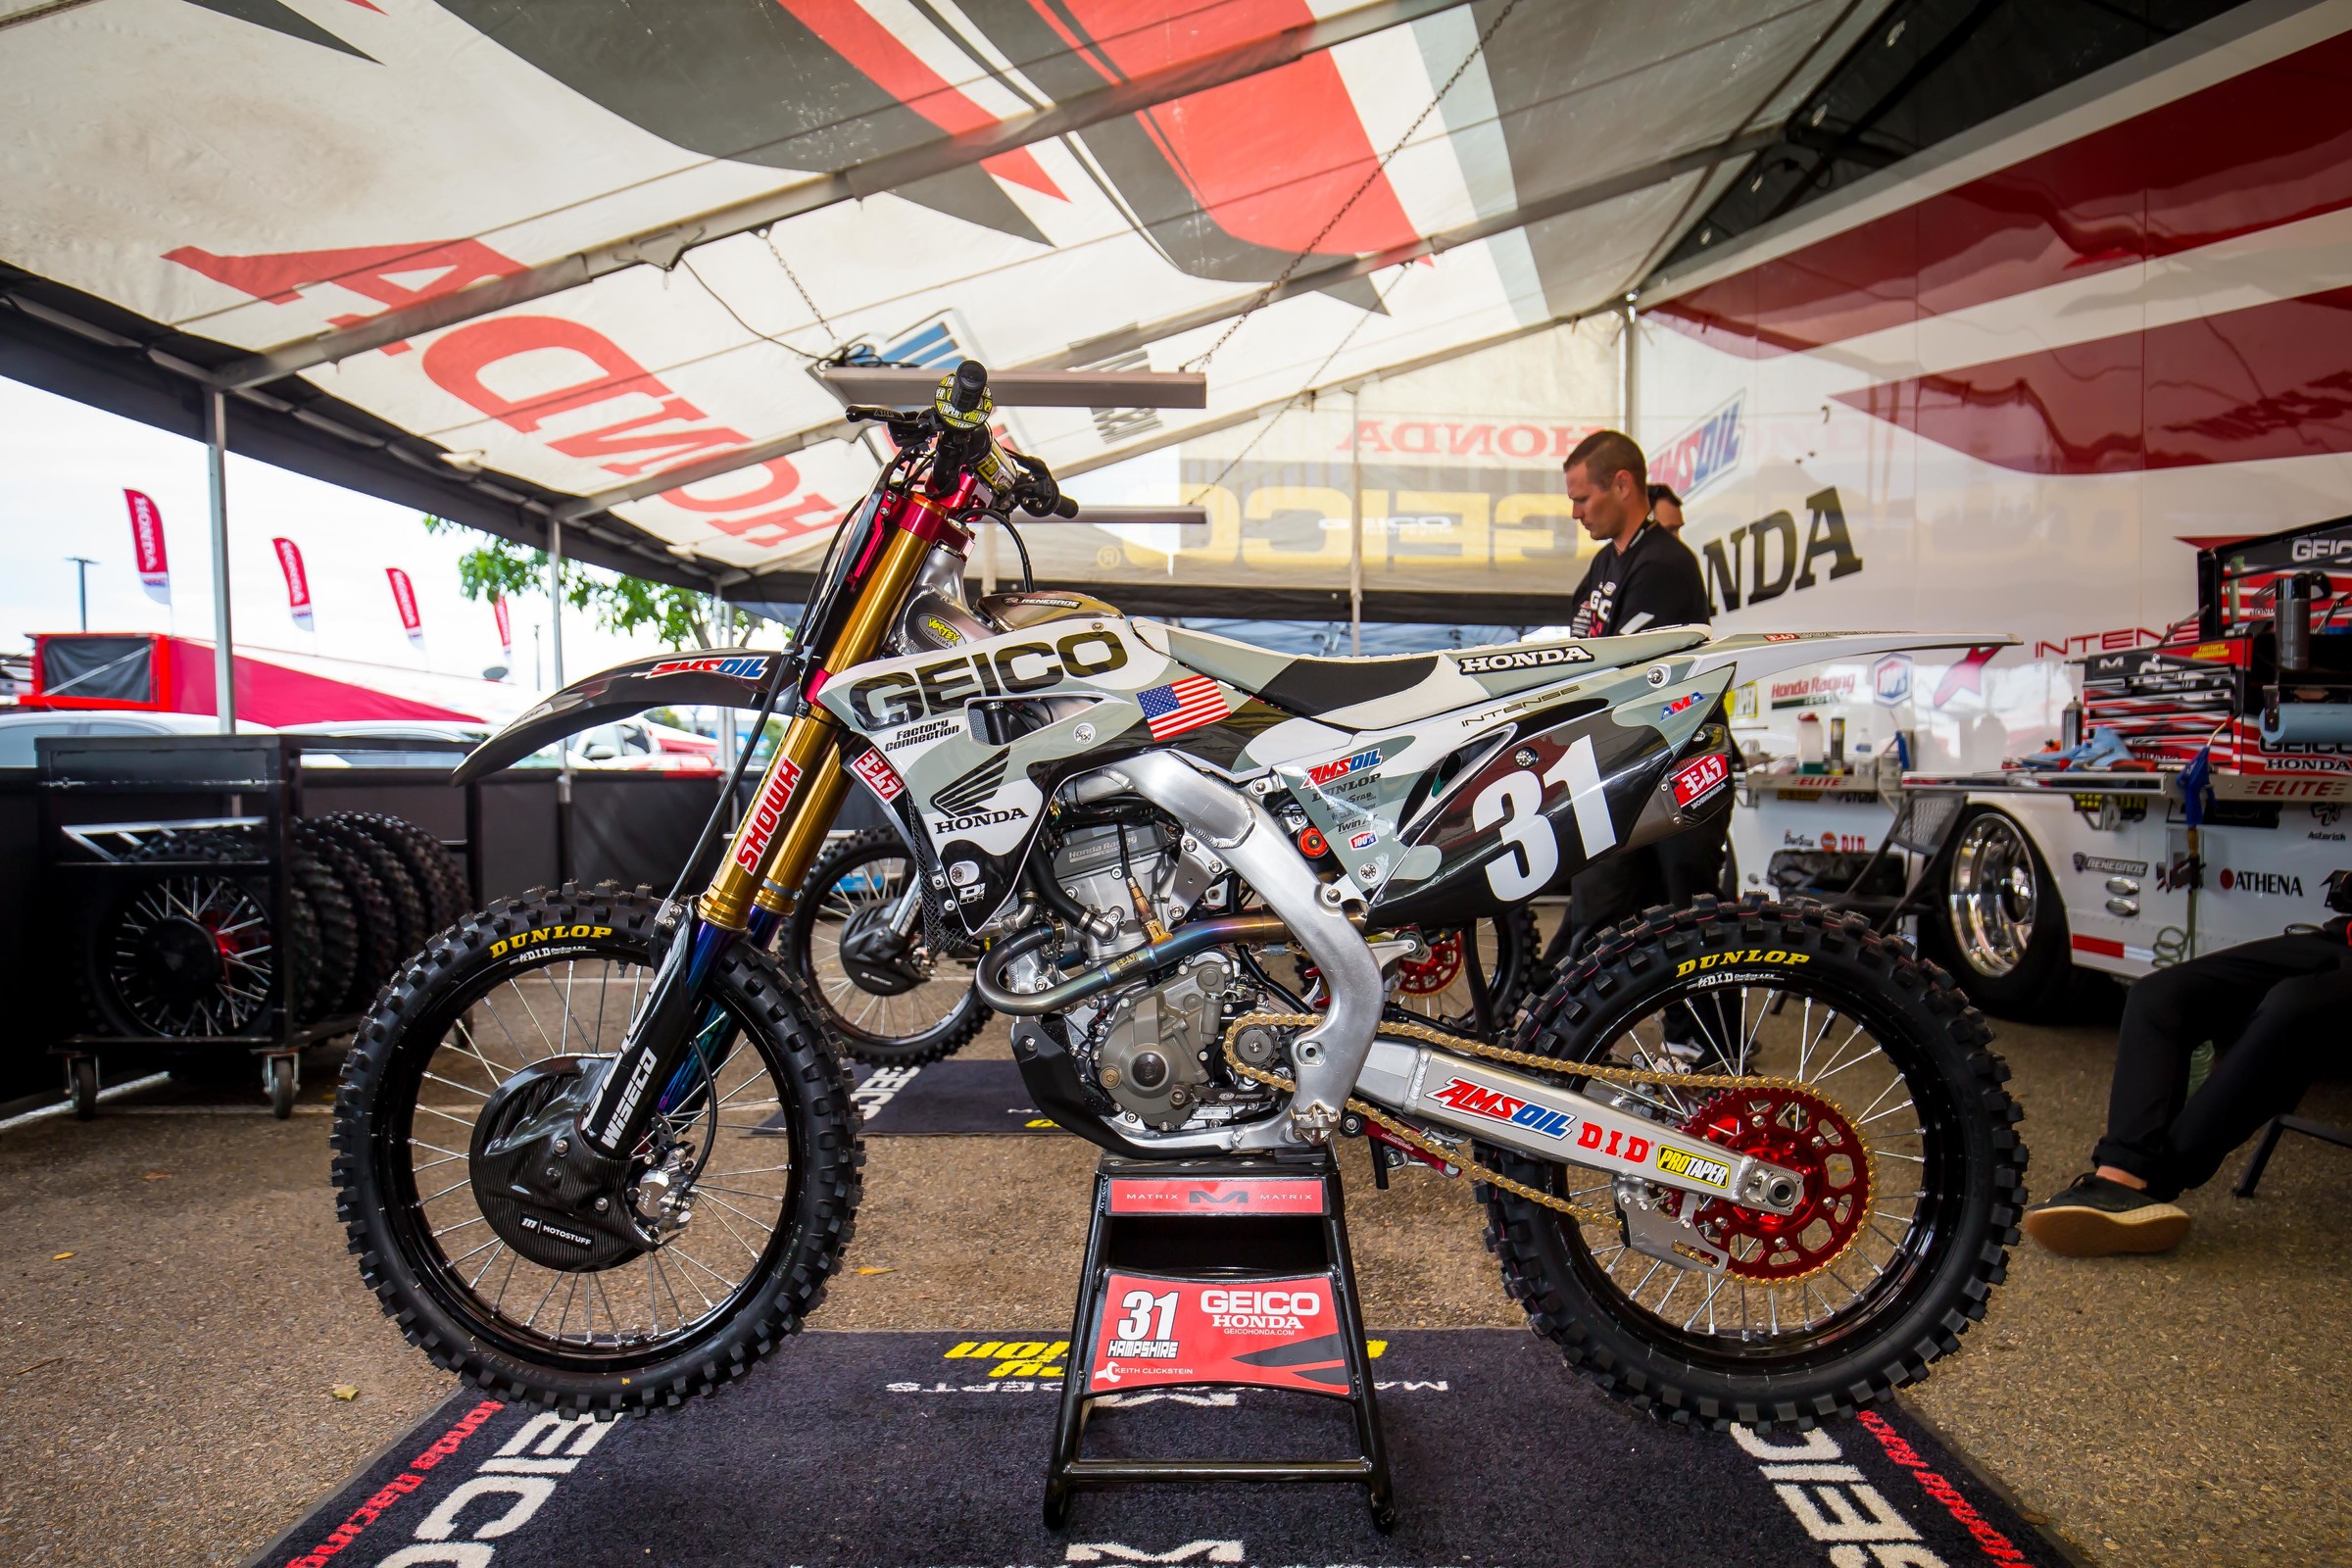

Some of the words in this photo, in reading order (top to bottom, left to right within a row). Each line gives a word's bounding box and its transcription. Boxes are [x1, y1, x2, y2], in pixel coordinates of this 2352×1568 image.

[133, 496, 158, 570] HONDA
[1702, 486, 1863, 617] NDA
[2292, 539, 2352, 563] GEIC
[1021, 598, 1080, 609] RENEGADE
[927, 616, 960, 646] VORTEX
[1460, 648, 1592, 673] HONDA
[850, 631, 1129, 731] GEICO
[1461, 685, 1580, 727] INTENSE
[1659, 692, 1706, 722] AMA
[896, 718, 950, 740] Factory
[1302, 750, 1381, 788] AMSOIL
[2266, 759, 2352, 771] HONDA
[2257, 780, 2331, 797] ELITE
[737, 758, 801, 872] SHOWA
[935, 808, 1029, 834] HONDA
[1473, 734, 1616, 902] 31
[1068, 845, 1103, 859] Honda
[1353, 833, 1377, 848] 100%
[2234, 870, 2303, 897] ATHENA
[490, 925, 612, 958] DUNLOP
[1676, 950, 1810, 978] DUNLOP
[1433, 1078, 1574, 1138] AMSOIL
[1660, 1150, 1729, 1186] PROTAPER
[542, 1225, 592, 1247] MOTOSTUFF
[1116, 1290, 1180, 1341] 31
[1200, 1290, 1321, 1315] GEICO
[1211, 1315, 1304, 1329] HONDA
[1223, 1328, 1296, 1337] GEICOHONDA.COM
[1106, 1340, 1180, 1359] HAMPSHIRE
